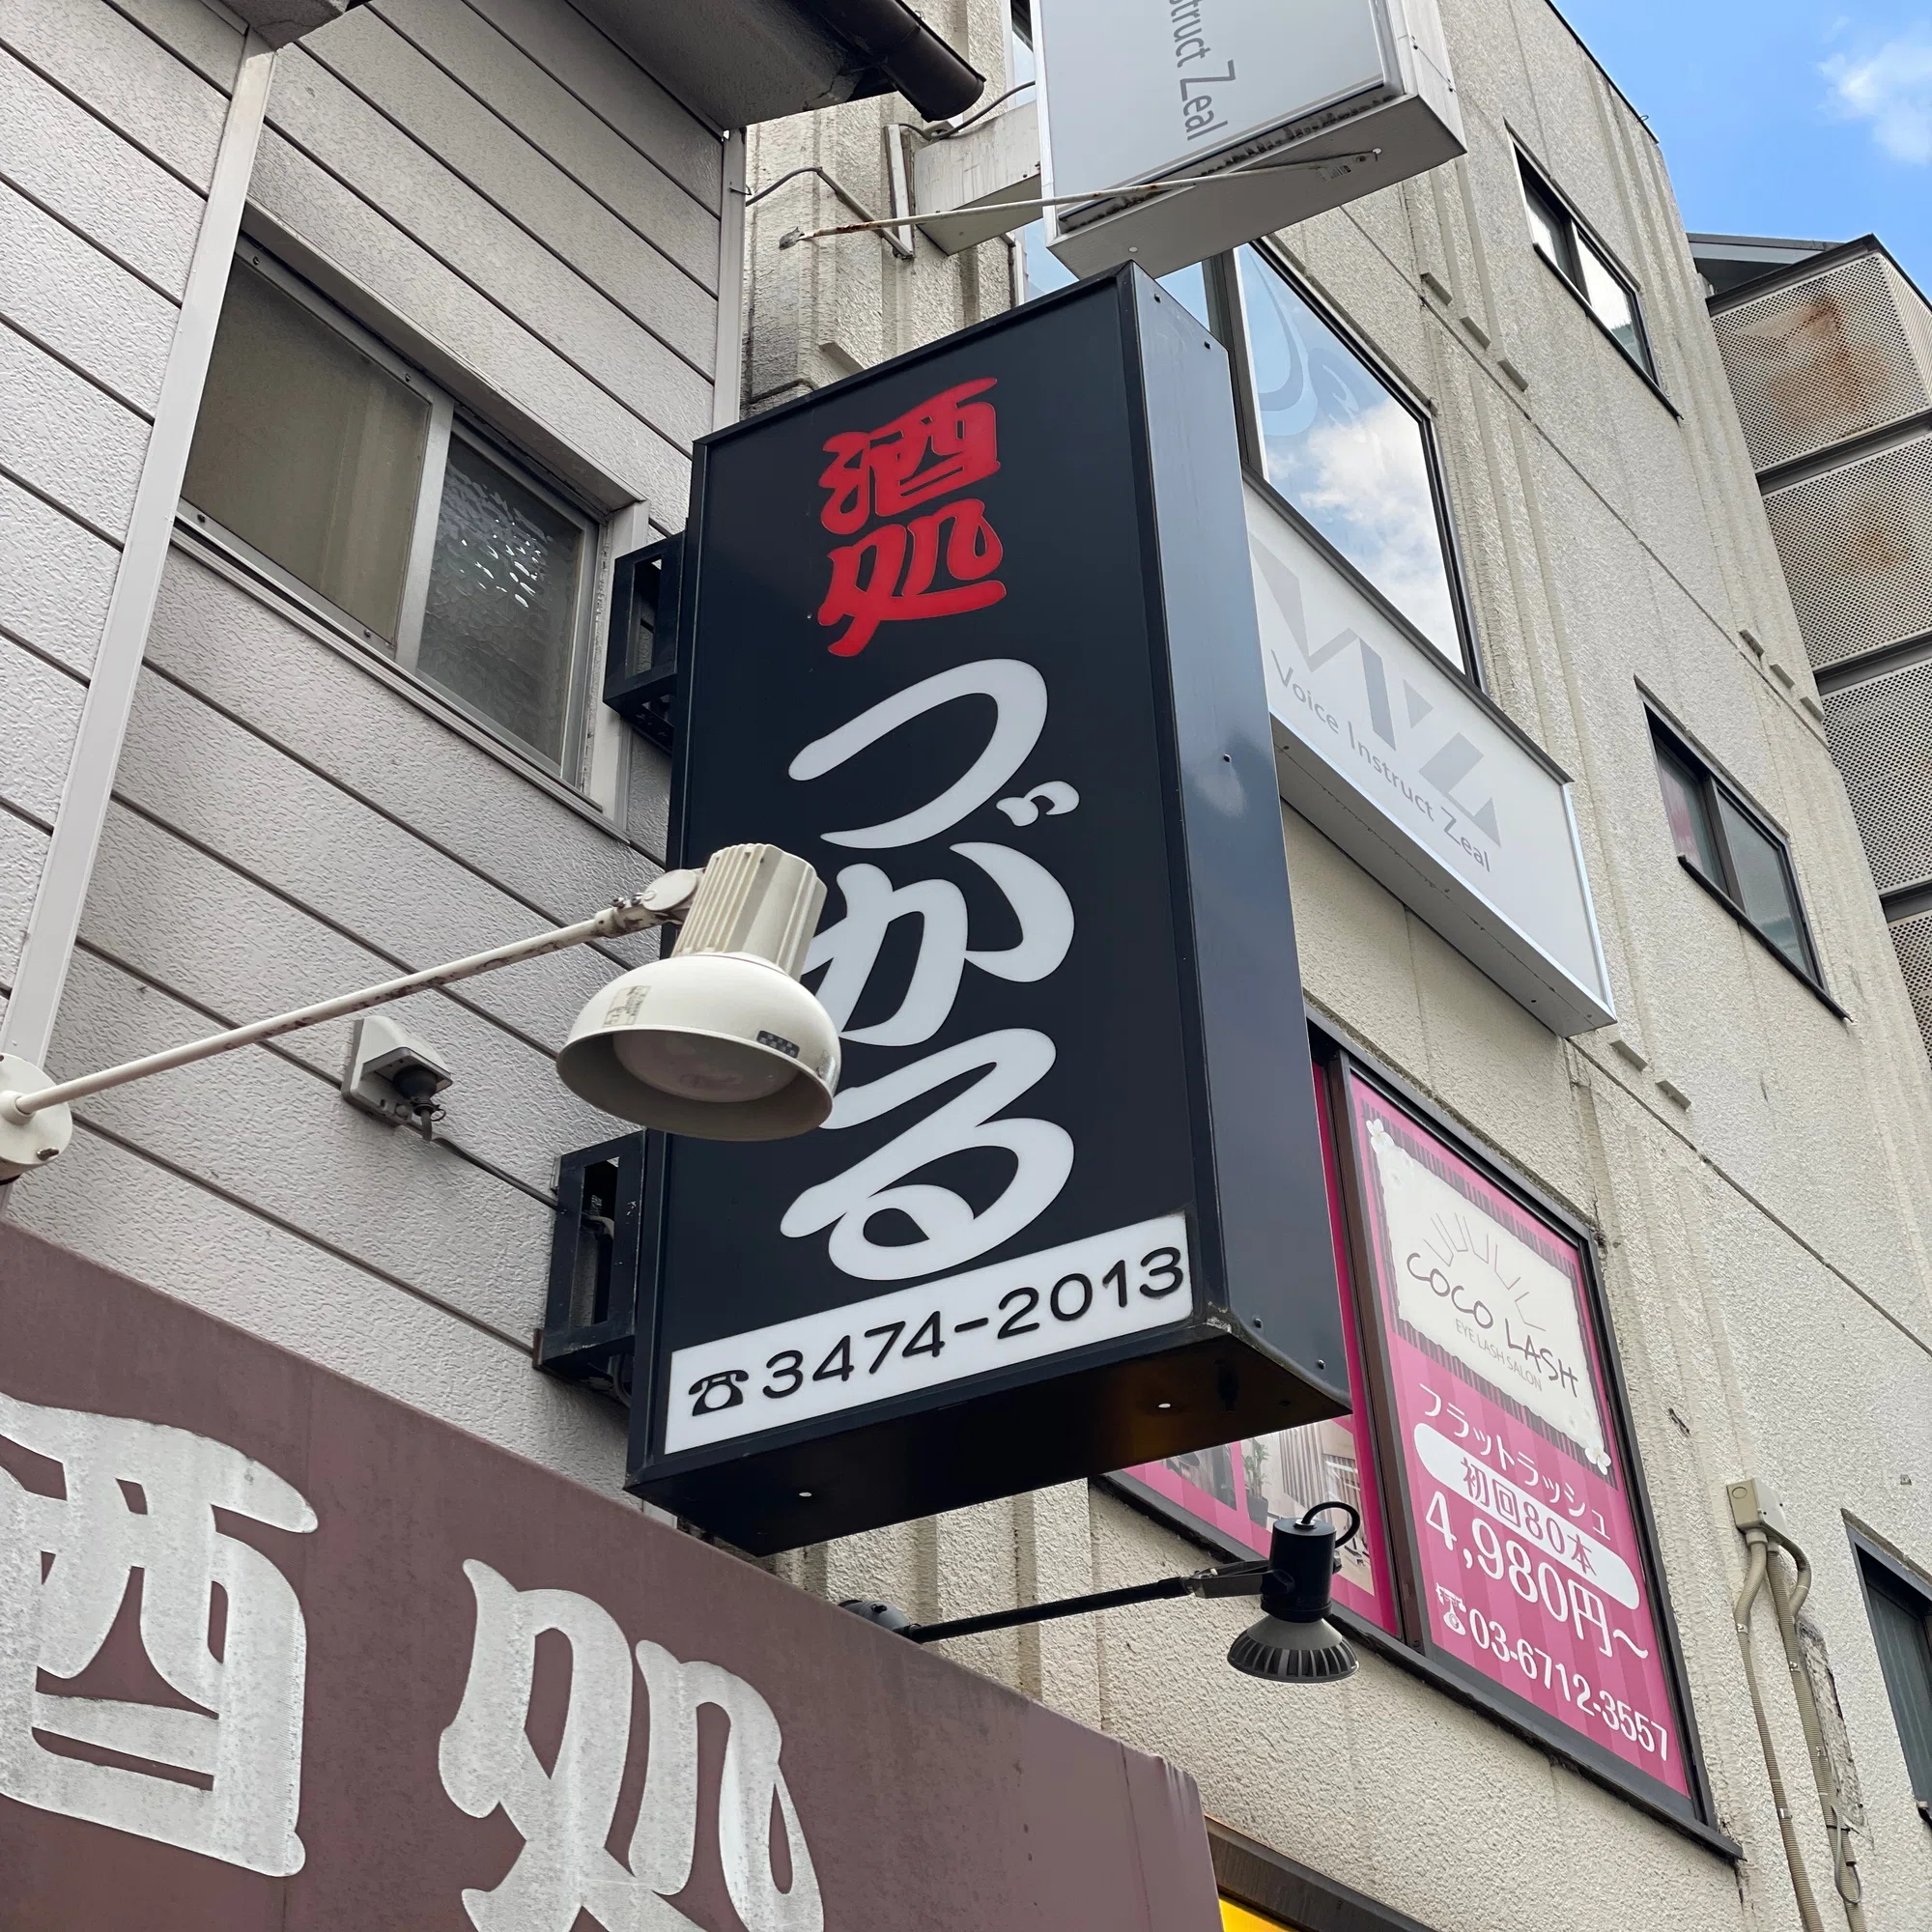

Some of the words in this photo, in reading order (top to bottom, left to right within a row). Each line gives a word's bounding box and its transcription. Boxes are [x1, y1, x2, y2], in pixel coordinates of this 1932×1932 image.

[1179, 59, 1236, 141] Zeal
[818, 378, 1008, 658] 酒処
[1270, 648, 1339, 734] Voice
[1348, 721, 1435, 822] Instruct
[1440, 806, 1491, 873] Zeal
[780, 658, 1079, 1281] つがる
[762, 1246, 1184, 1399] 3474-2013
[1406, 1252, 1494, 1329] COCO
[1504, 1318, 1578, 1398] LASH
[1506, 1355, 1543, 1392] SALON
[1419, 1383, 1611, 1541] フラットラッシュ
[1461, 1457, 1598, 1575] 初回80本
[1469, 1608, 1667, 1762] 03-6712-3557
